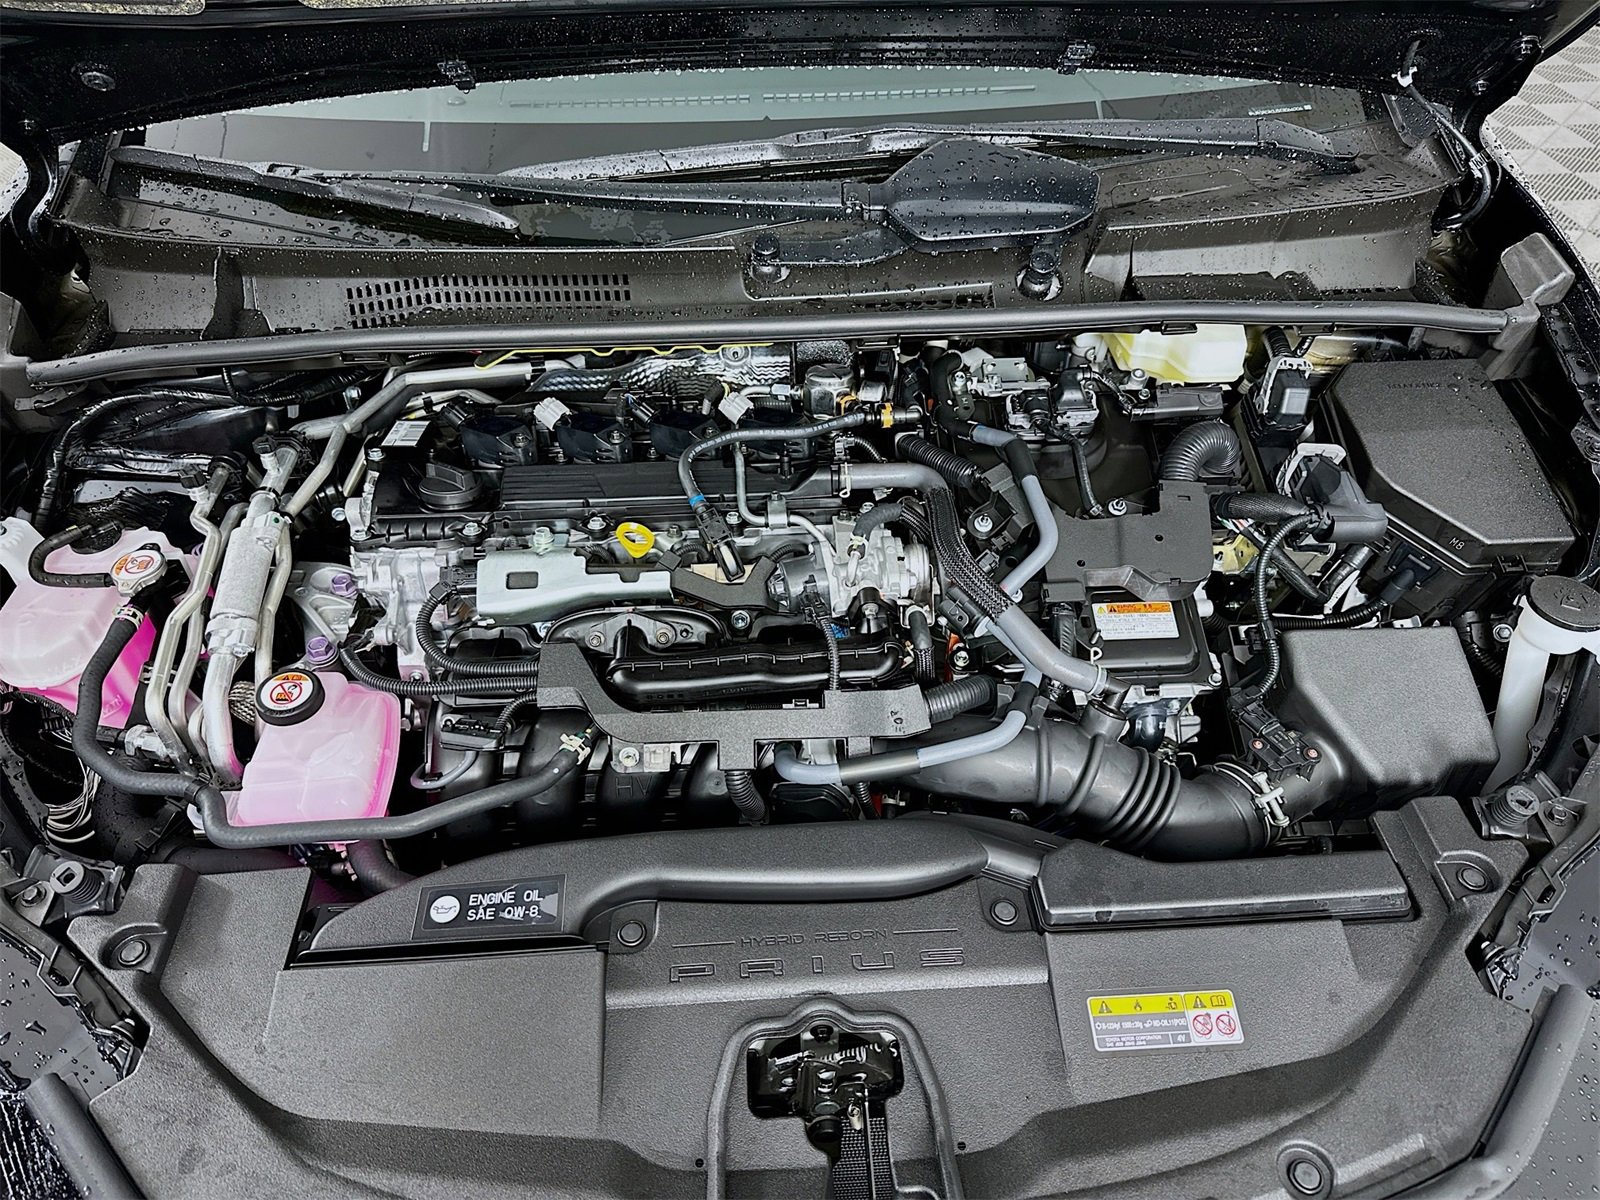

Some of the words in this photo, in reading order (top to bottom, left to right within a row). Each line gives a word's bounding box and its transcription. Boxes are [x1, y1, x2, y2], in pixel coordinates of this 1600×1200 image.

[469, 891, 516, 906] ENGINE
[523, 889, 543, 902] OIL
[466, 907, 496, 921] SAE
[740, 934, 805, 948] HYBRID
[814, 928, 888, 943] REBORN
[669, 947, 965, 982] PRIUS
